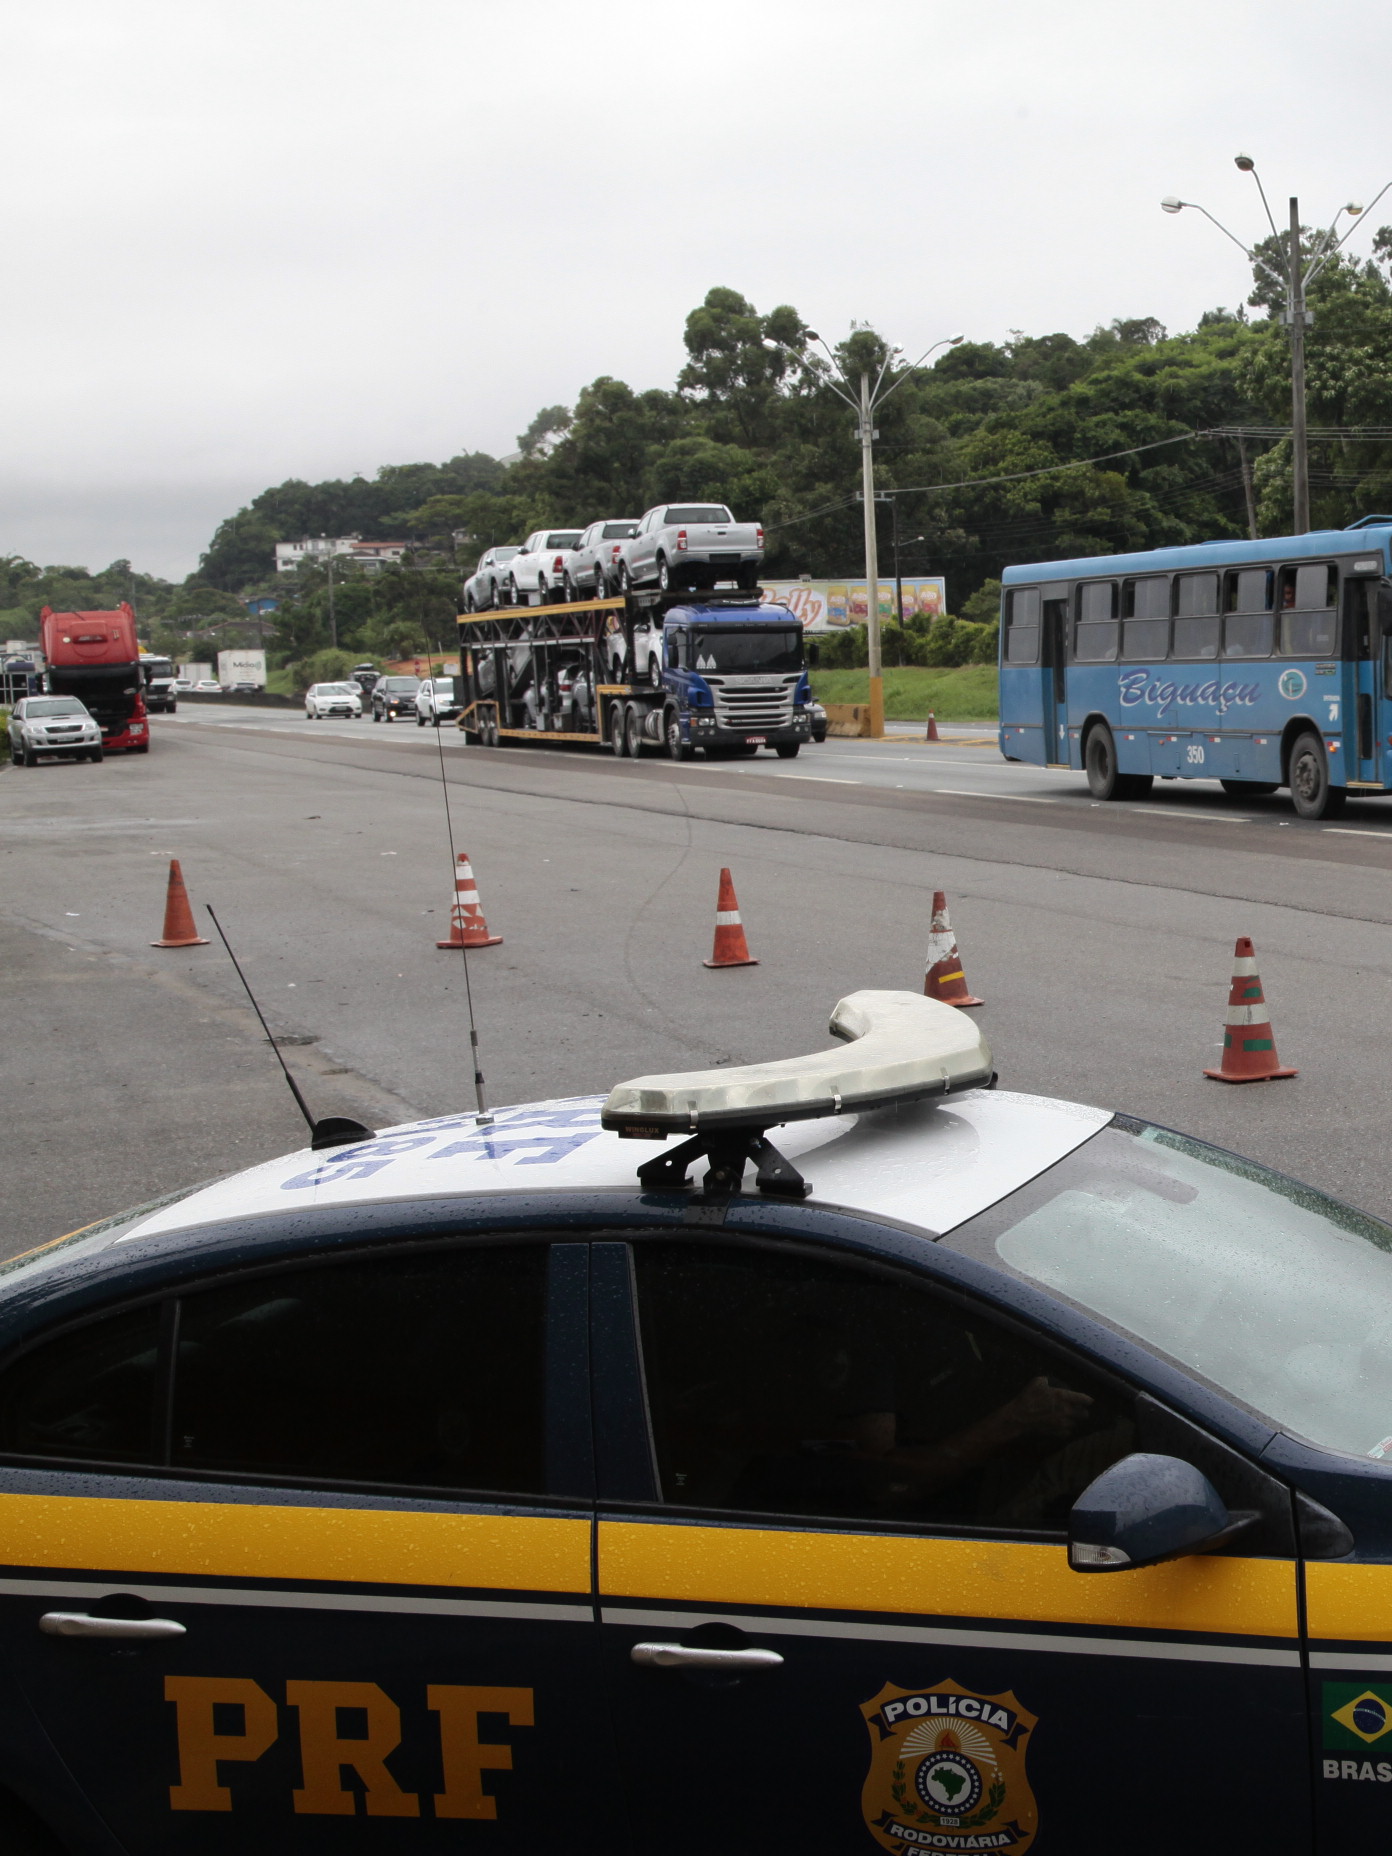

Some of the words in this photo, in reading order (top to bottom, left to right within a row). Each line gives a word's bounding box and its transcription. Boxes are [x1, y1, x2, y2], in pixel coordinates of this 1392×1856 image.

[1118, 668, 1262, 719] Biguaçu
[1187, 745, 1205, 764] 350
[884, 1695, 1009, 1731] POLÍCIA
[164, 1675, 535, 1820] PRF
[889, 1824, 1012, 1849] RODOVIÁRIA
[941, 1817, 959, 1826] 1928
